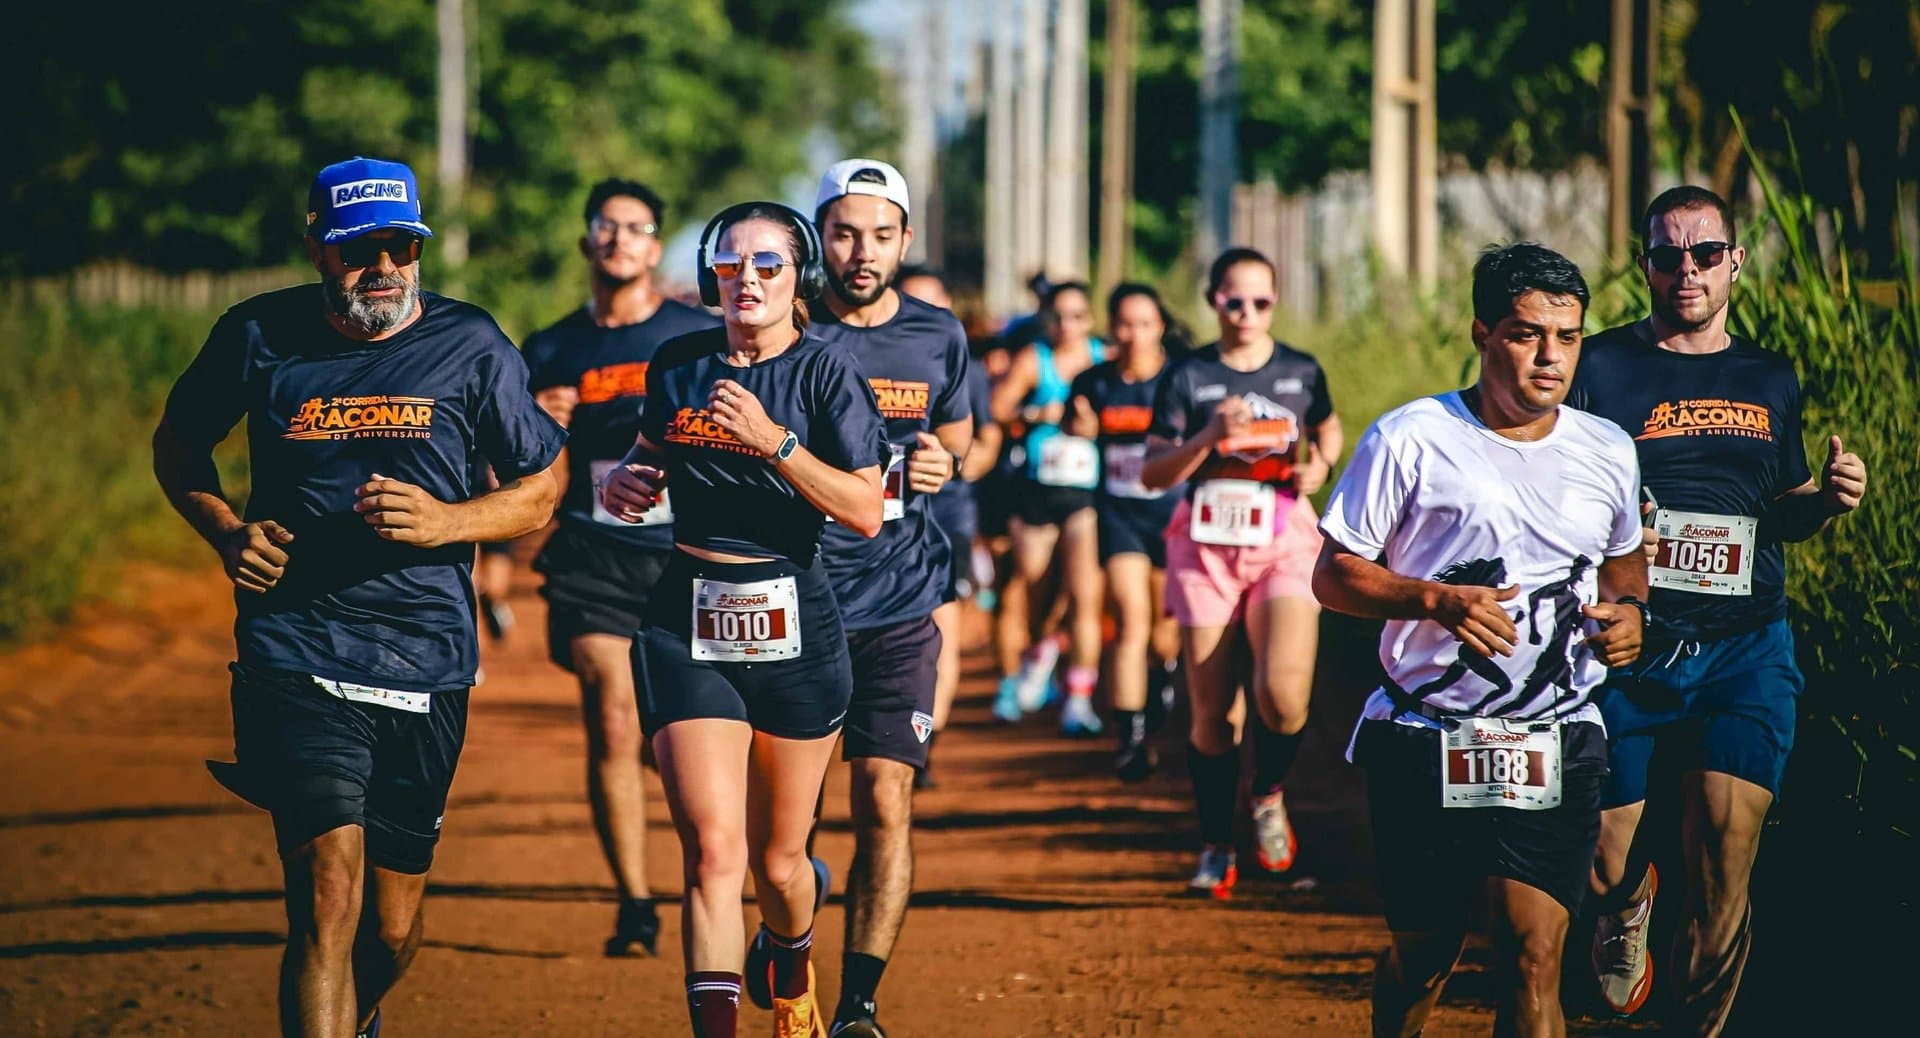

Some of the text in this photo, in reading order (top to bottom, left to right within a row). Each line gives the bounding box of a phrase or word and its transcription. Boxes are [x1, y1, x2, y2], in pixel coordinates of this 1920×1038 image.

[336, 183, 403, 204] RACING
[342, 396, 389, 406] CORRIDA
[1690, 400, 1732, 408] CORRIDA
[325, 405, 432, 428] ACONAR
[1677, 408, 1771, 432] ACONAR
[684, 417, 732, 440] ACO
[1692, 527, 1730, 538] ACONAR
[1667, 541, 1729, 573] 1056
[728, 596, 768, 605] ACONAR
[708, 612, 770, 640] 1010
[1462, 749, 1529, 785] 1188
